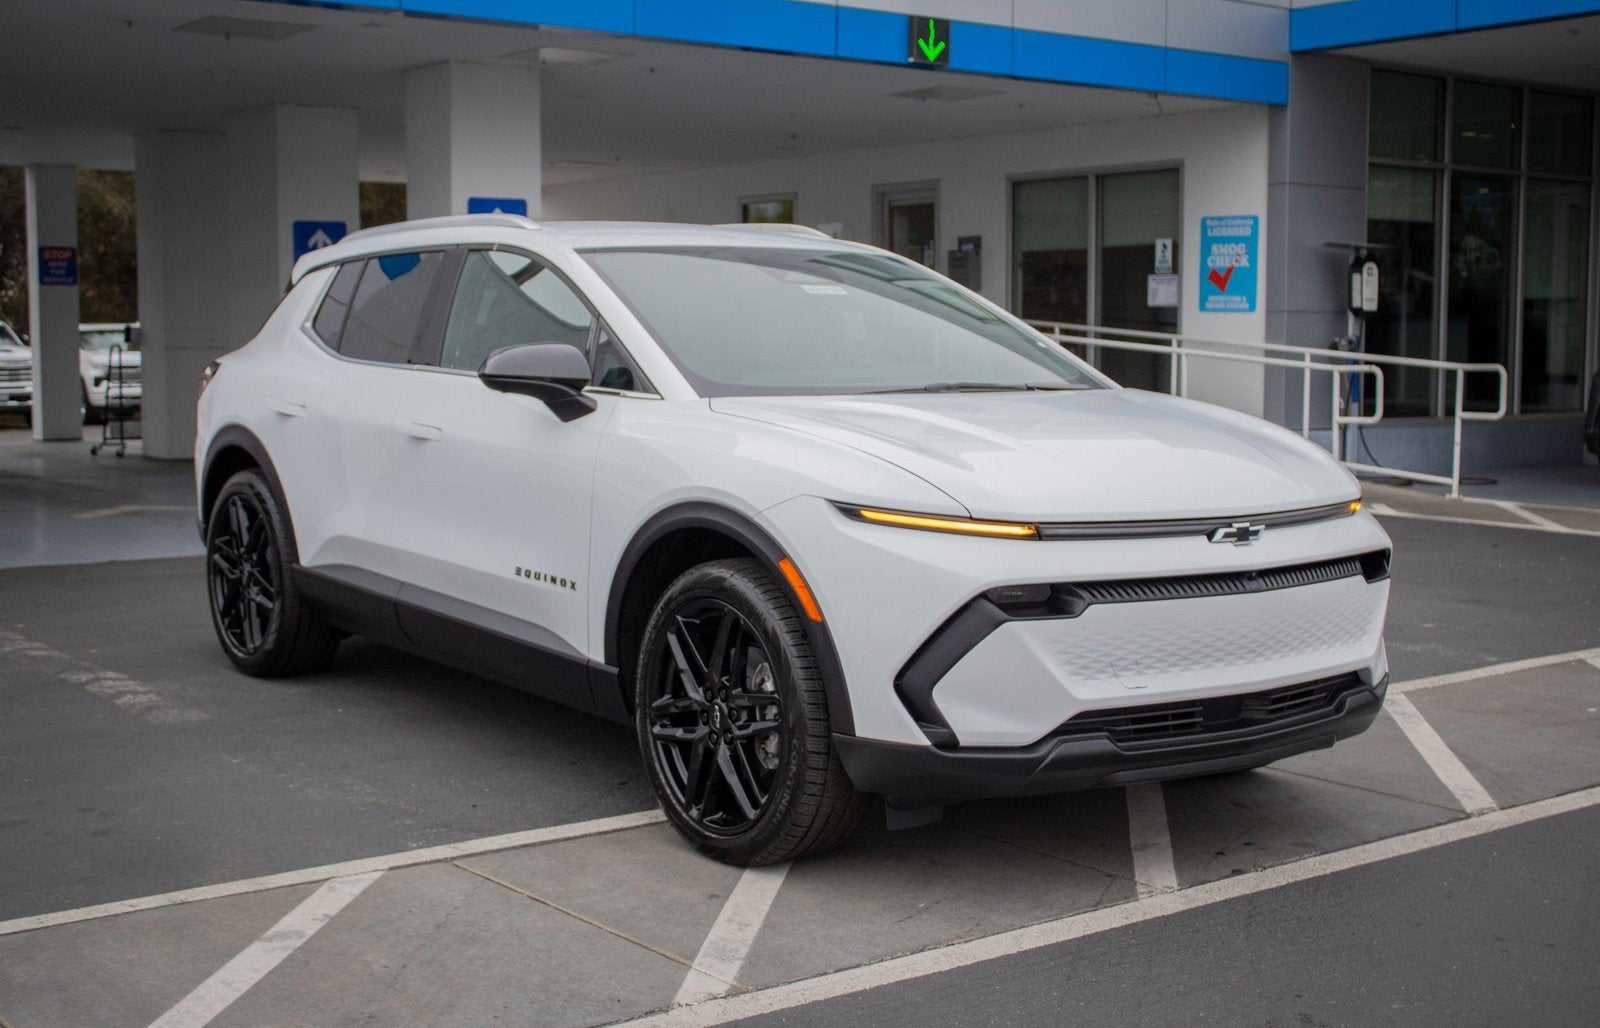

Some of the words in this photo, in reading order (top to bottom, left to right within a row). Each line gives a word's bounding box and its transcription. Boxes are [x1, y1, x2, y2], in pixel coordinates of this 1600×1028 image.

[1207, 227, 1251, 237] LICENSED
[42, 249, 73, 260] STOP
[1211, 243, 1247, 255] SMOG
[1206, 254, 1250, 268] CHECK
[514, 565, 577, 591] EQUINOX
[764, 738, 799, 832] CONTINEN
